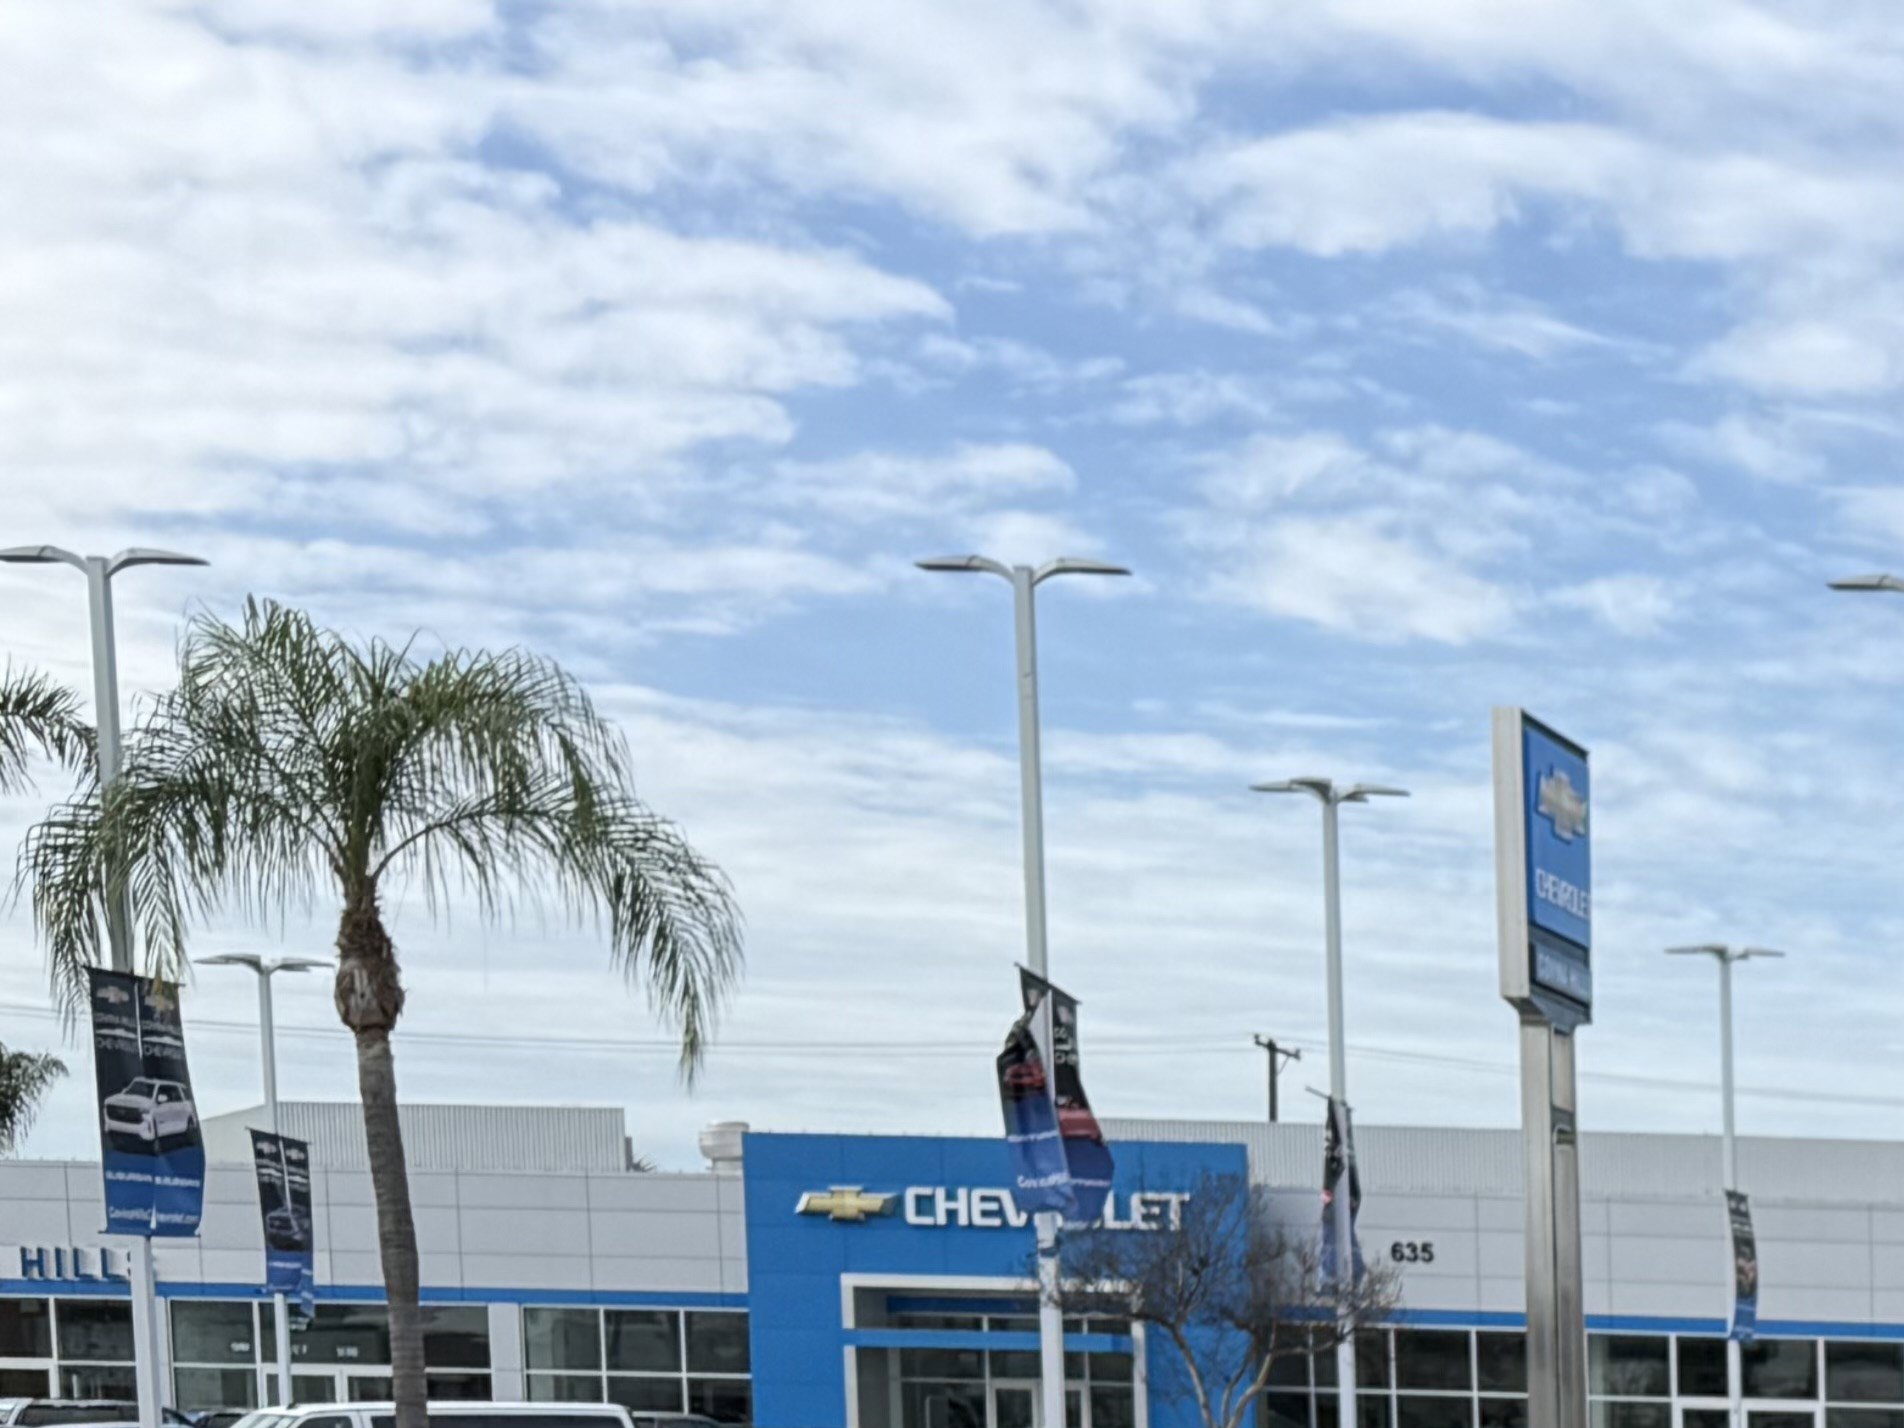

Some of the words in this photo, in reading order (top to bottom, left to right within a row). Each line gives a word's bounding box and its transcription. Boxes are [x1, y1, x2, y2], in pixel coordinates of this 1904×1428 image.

[905, 1186, 1190, 1231] CHEVLET
[20, 1246, 157, 1281] HILL
[1391, 1242, 1434, 1263] 635
